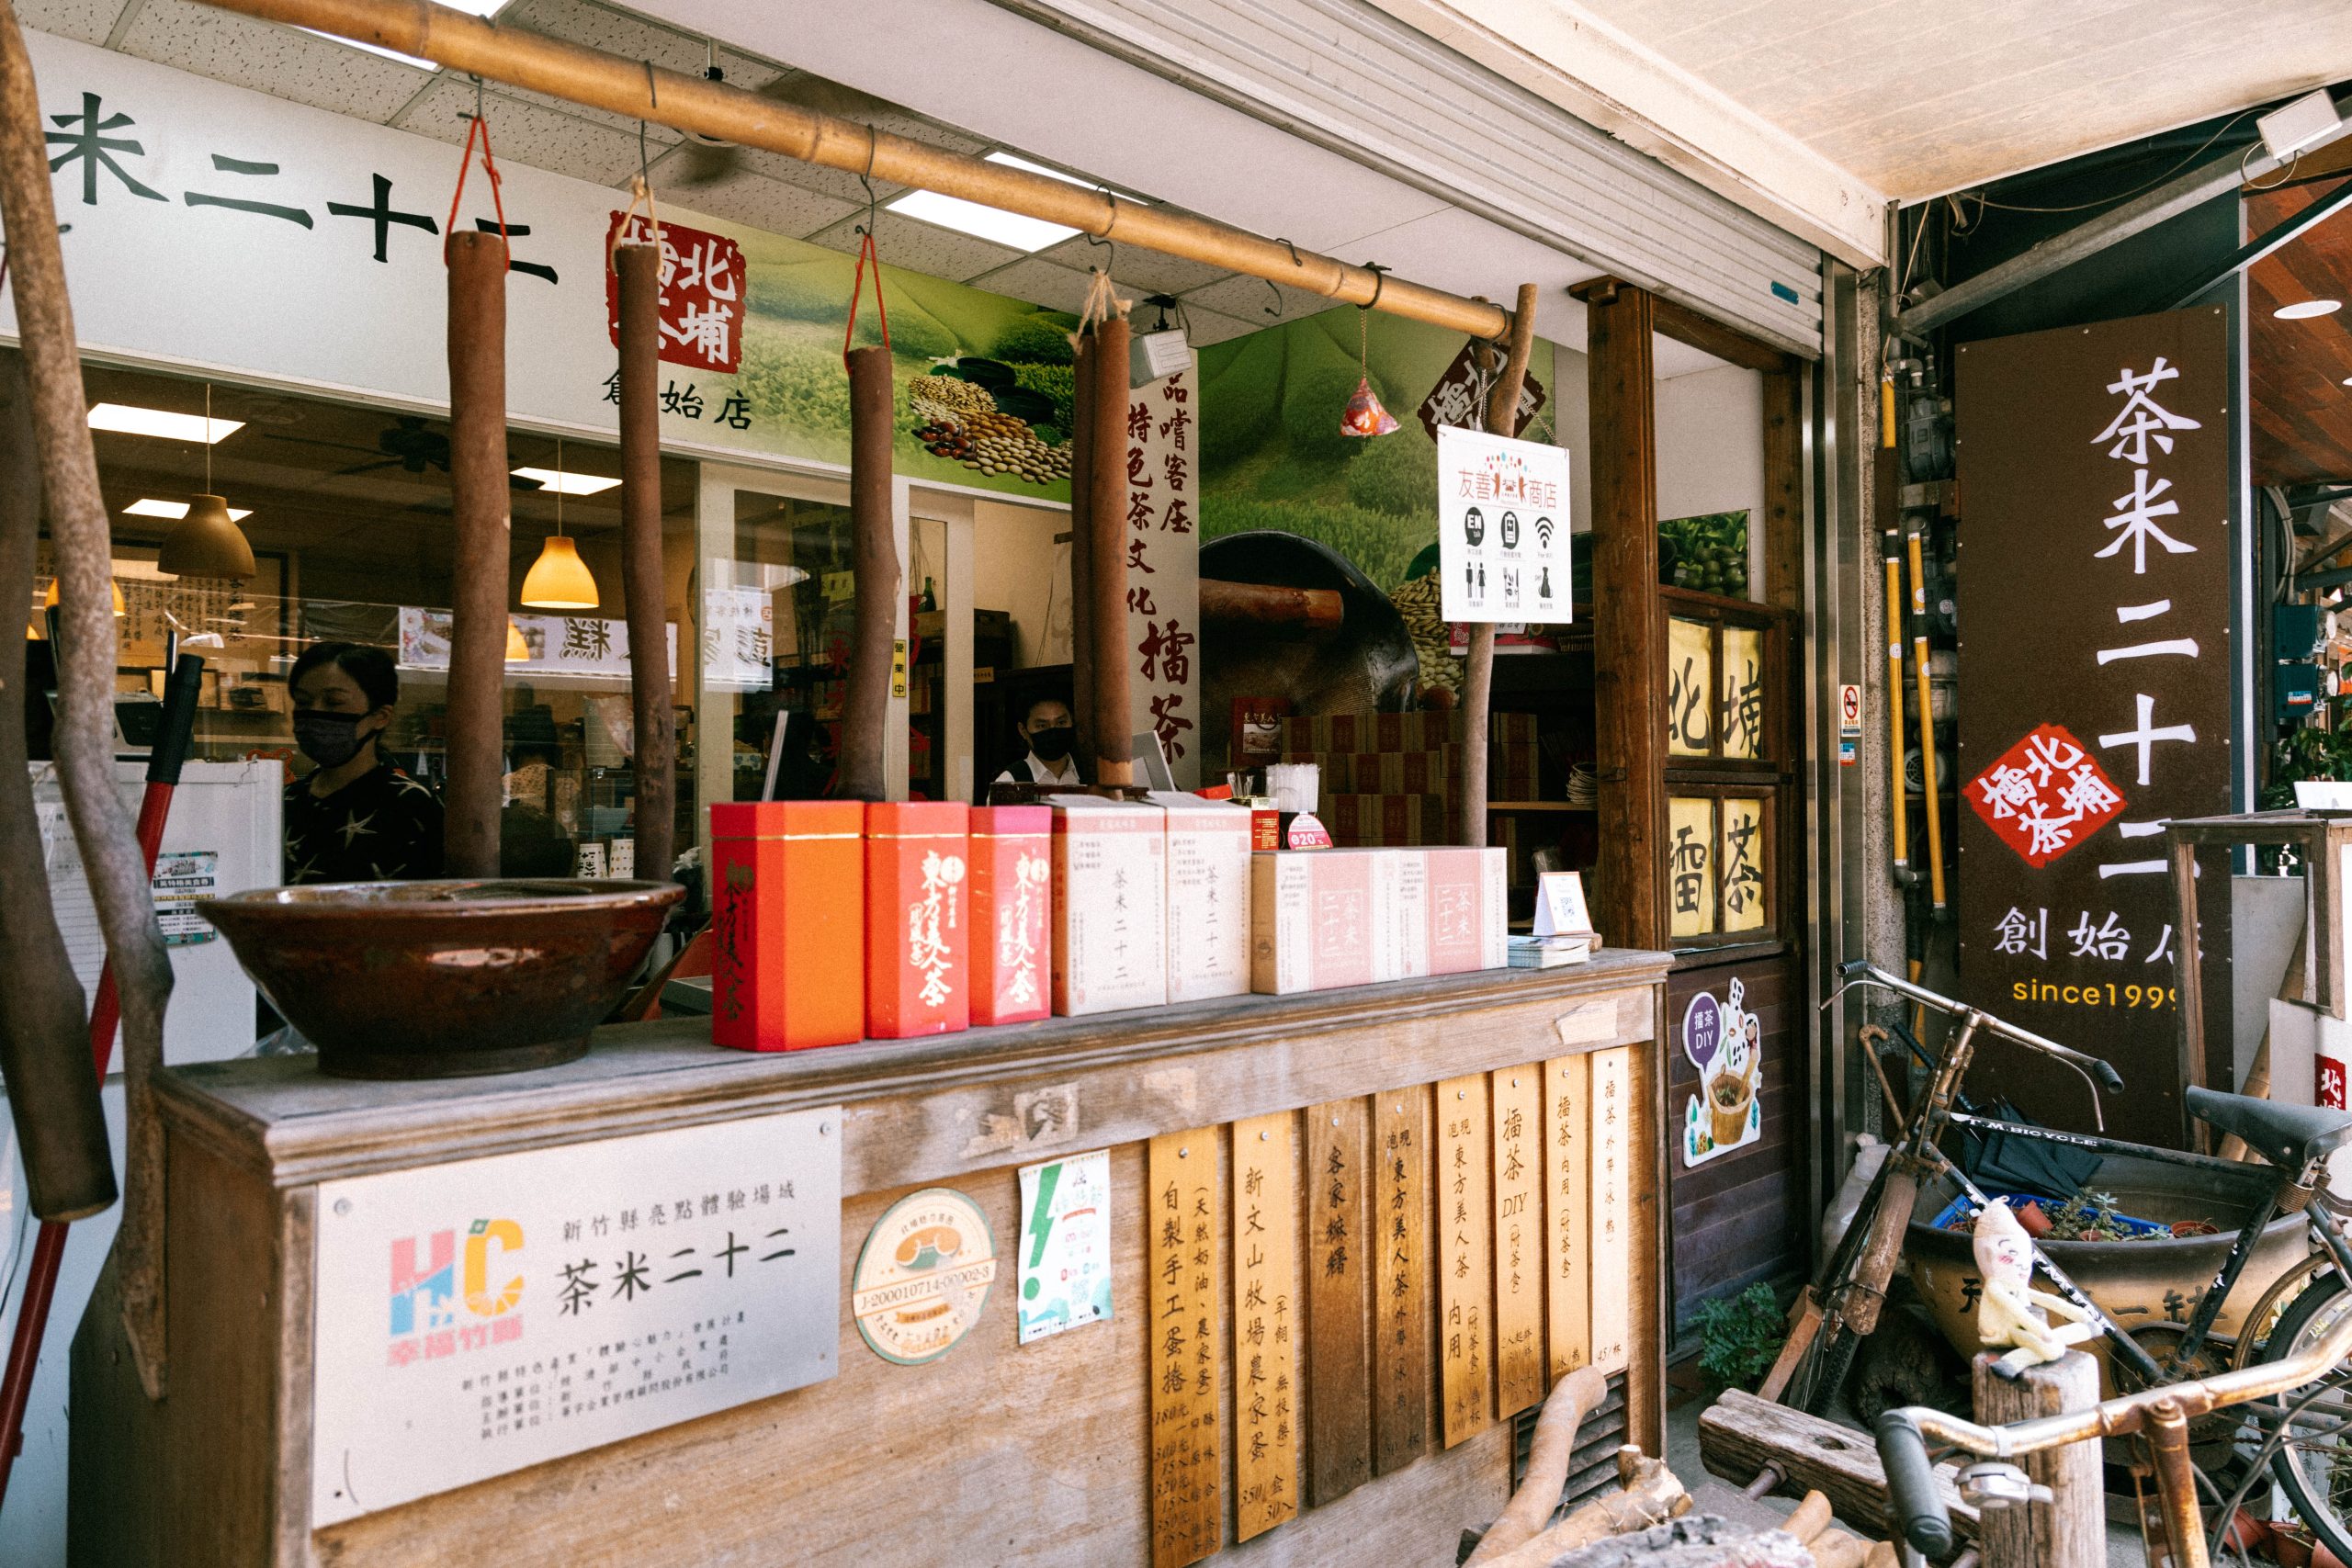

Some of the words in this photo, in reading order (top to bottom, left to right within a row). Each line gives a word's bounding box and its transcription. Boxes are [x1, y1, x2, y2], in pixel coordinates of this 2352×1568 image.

[676, 239, 734, 365] 北埔
[1458, 467, 1490, 501] 友善
[1529, 479, 1557, 509] 商店
[894, 643, 905, 695] 營業中
[2089, 356, 2202, 880] 茶米二十二
[1138, 618, 1195, 765] 擂茶
[920, 850, 953, 1007] 東方美人茶
[1010, 852, 1035, 1004] 東方美人茶
[1114, 867, 1128, 980] 茶米二十二
[1205, 864, 1219, 969] 茶米二十二
[1694, 1010, 1713, 1031] 擂茶
[1696, 1030, 1713, 1050] DIY
[1454, 1145, 1470, 1279] 東方美人茶
[555, 1228, 796, 1317] 茶米二十二
